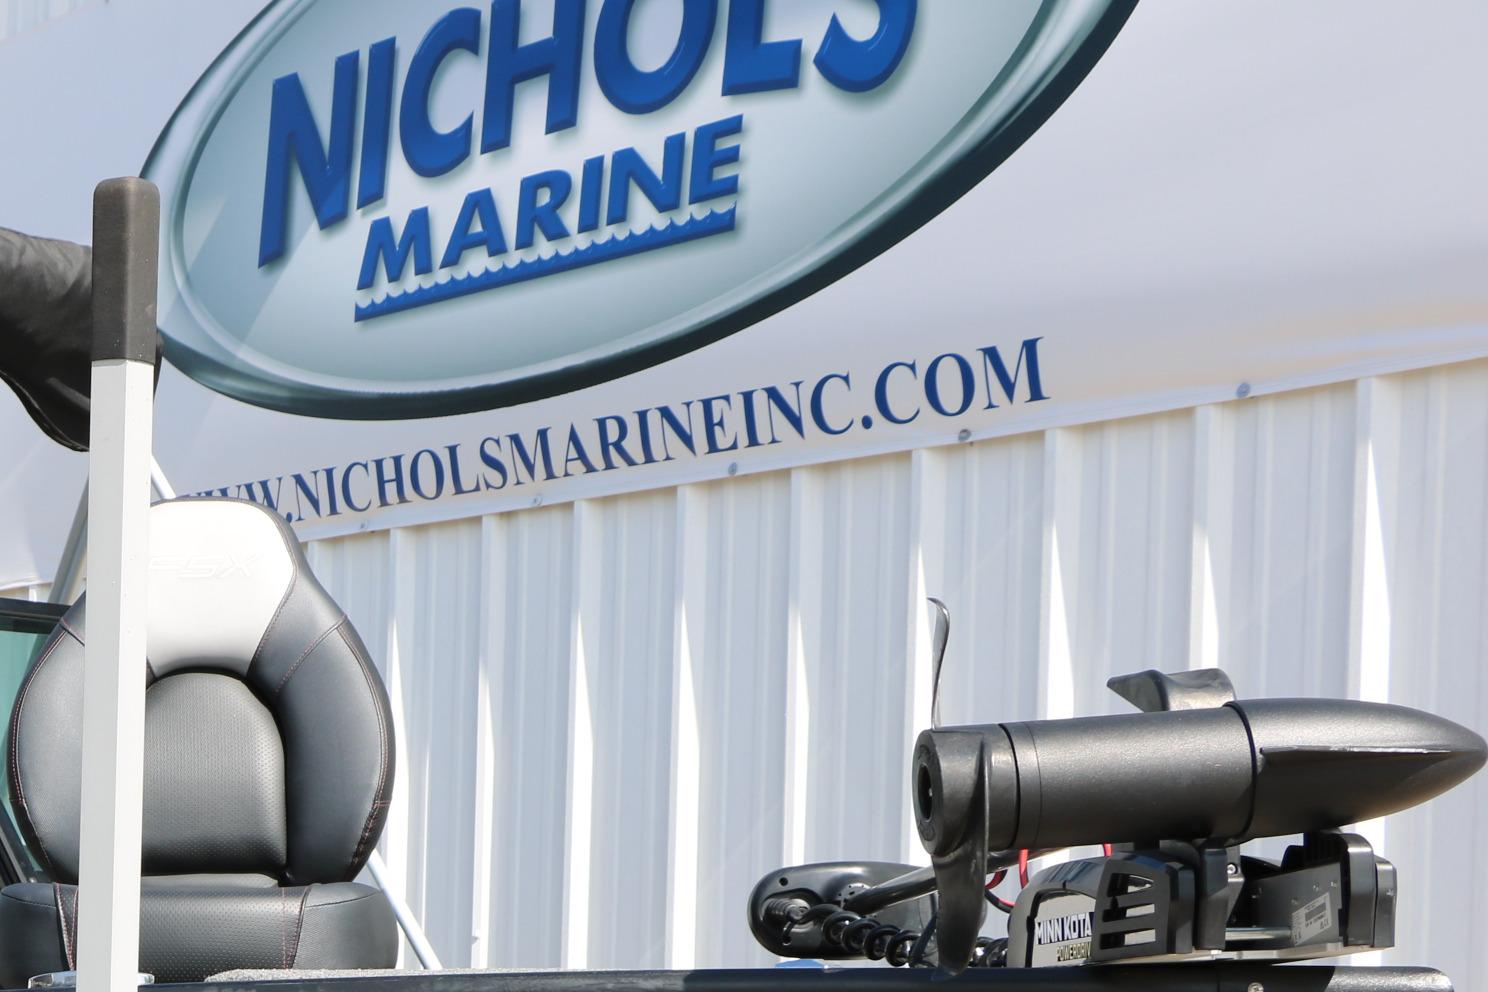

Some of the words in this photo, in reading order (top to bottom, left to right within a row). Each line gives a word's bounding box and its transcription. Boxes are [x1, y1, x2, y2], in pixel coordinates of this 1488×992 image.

[356, 113, 744, 291] MARINE
[176, 336, 1050, 524] W.NICHOLSMARINEINC.COM
[1034, 916, 1063, 945] MINN
[1063, 911, 1093, 940] KOTA
